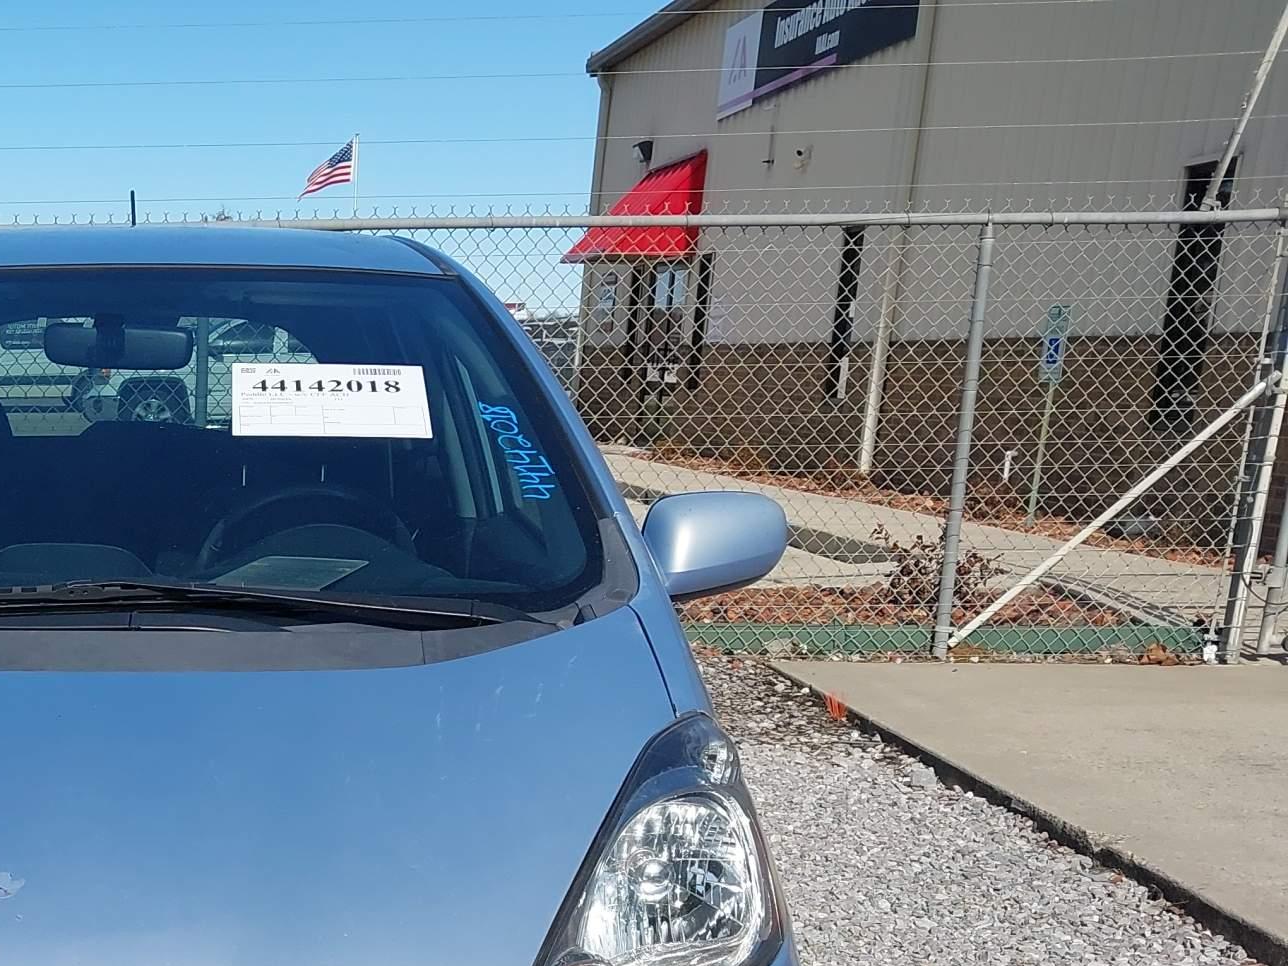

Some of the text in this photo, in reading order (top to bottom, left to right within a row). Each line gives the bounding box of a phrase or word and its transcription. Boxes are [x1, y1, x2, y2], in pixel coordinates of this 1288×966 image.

[774, 0, 823, 48] Insurance
[252, 379, 401, 393] 44142018
[478, 401, 555, 499] 44142018
